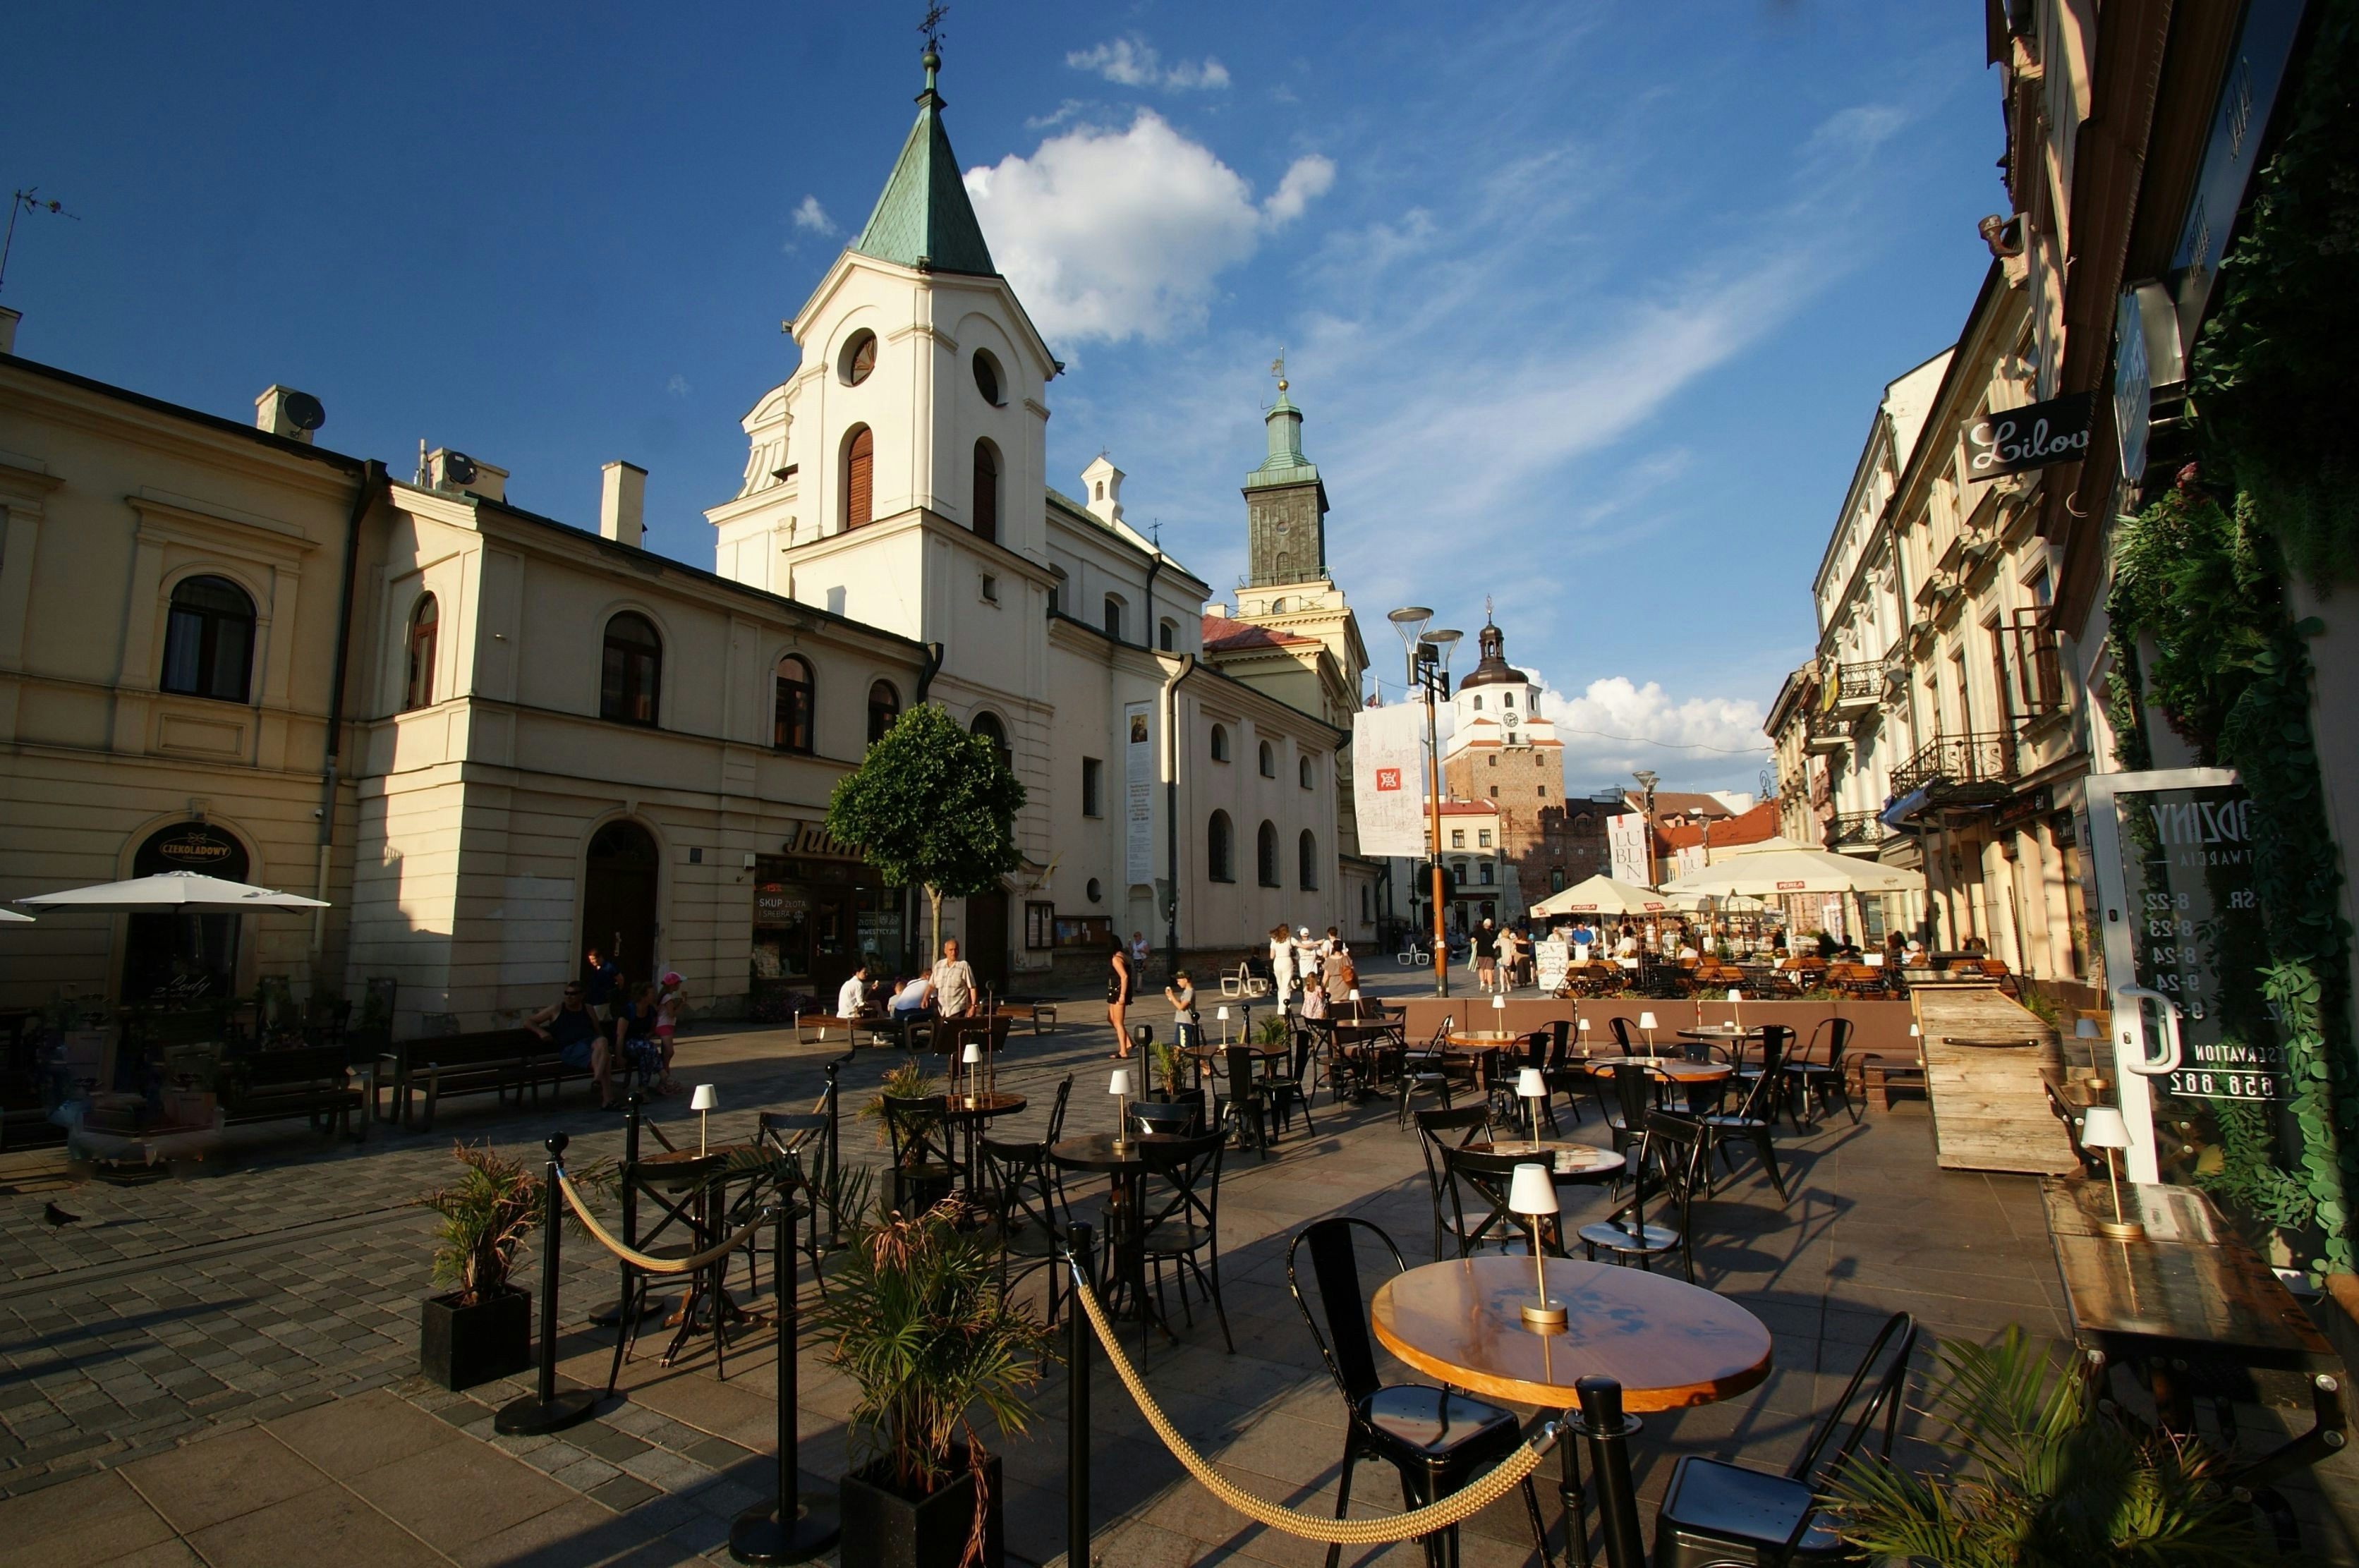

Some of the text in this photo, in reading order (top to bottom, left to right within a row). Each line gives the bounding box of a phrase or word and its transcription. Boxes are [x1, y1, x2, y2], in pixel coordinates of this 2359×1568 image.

[1615, 831, 1640, 846] LU
[162, 844, 228, 856] CZEKOLADOWY
[1615, 848, 1644, 863] BLI
[1627, 864, 1642, 880] N
[759, 898, 782, 907] SKUP
